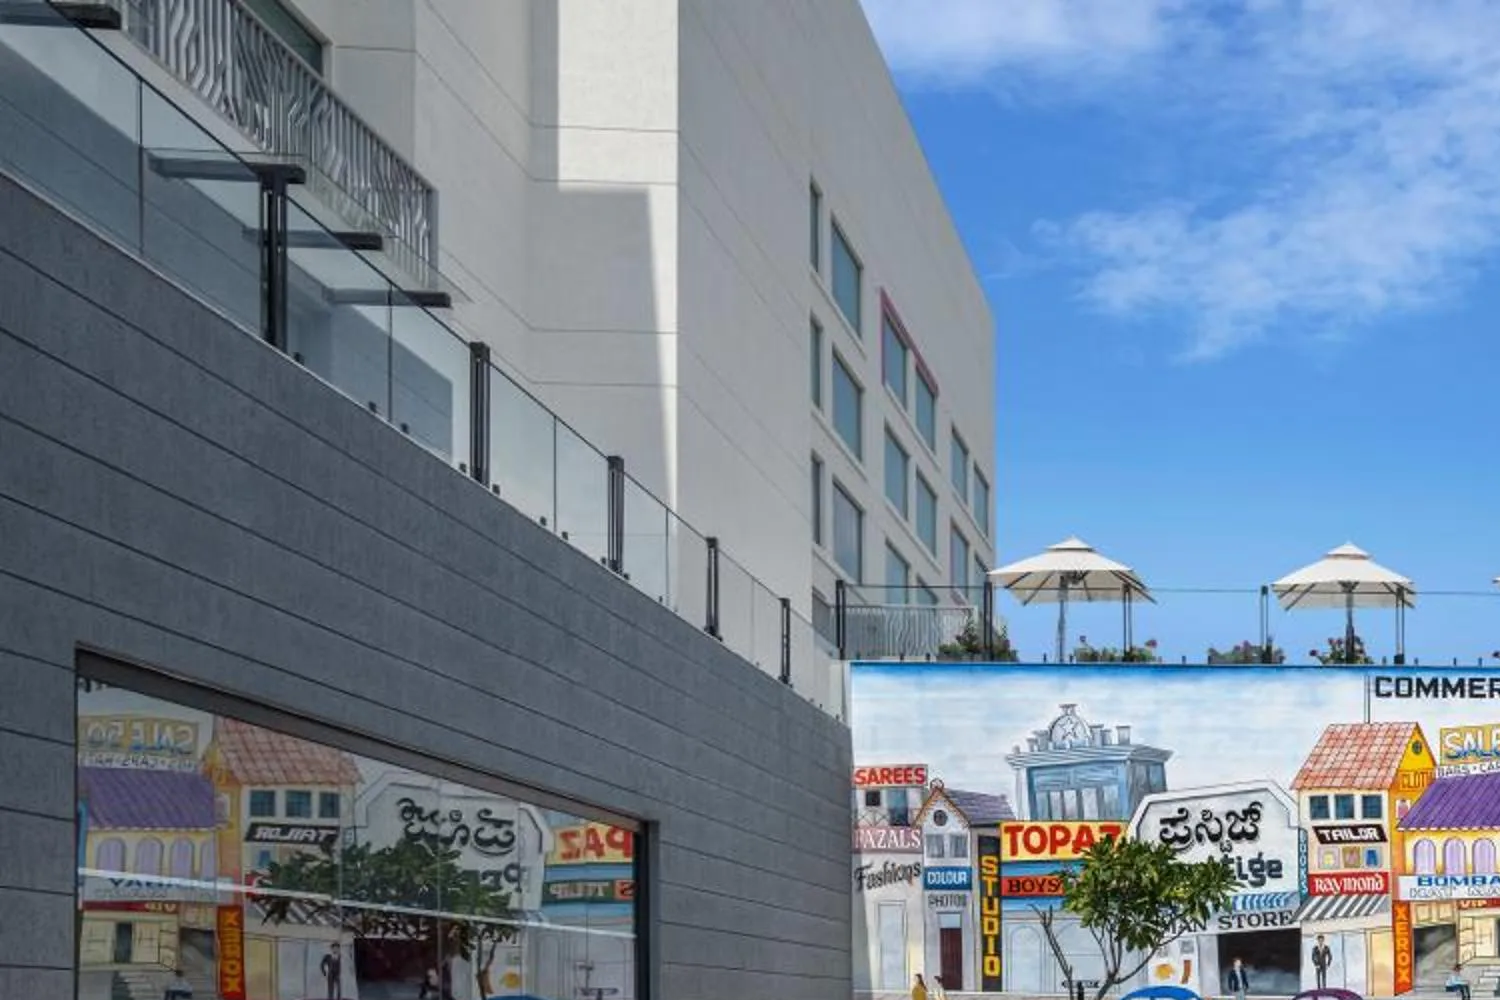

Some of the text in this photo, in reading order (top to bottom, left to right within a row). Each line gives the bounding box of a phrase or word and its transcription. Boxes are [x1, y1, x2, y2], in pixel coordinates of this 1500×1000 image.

[855, 767, 926, 785] SAREES
[855, 828, 921, 850] FAZALS
[1319, 828, 1380, 841] TAILOR
[855, 861, 921, 892] Fashions
[928, 871, 968, 885] COLOUR
[1314, 873, 1385, 894] Raymond
[981, 856, 1000, 977] STUDIO
[1218, 910, 1296, 931] STORE
[1395, 904, 1411, 984] XEROX
